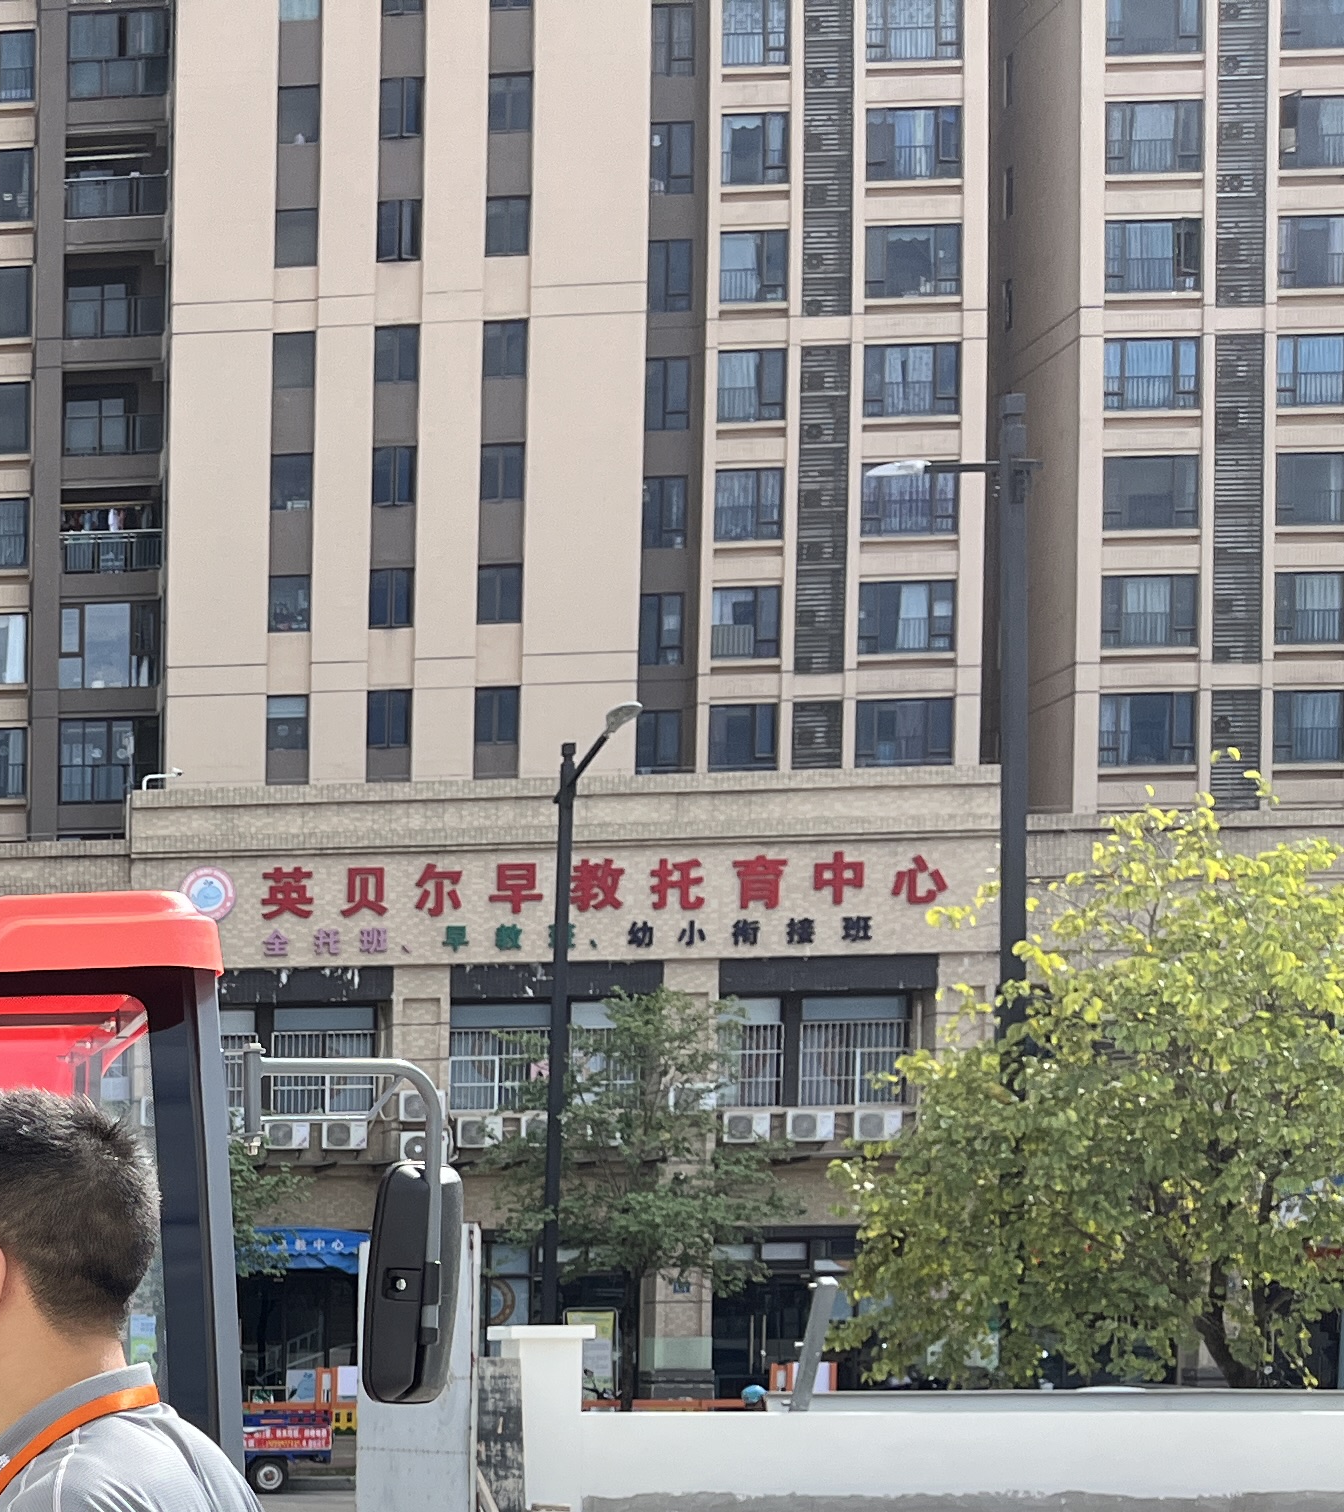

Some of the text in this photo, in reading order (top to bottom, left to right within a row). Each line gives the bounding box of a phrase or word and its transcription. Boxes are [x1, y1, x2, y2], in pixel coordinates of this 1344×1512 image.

[261, 851, 949, 920] 英贝尔早教托育中心
